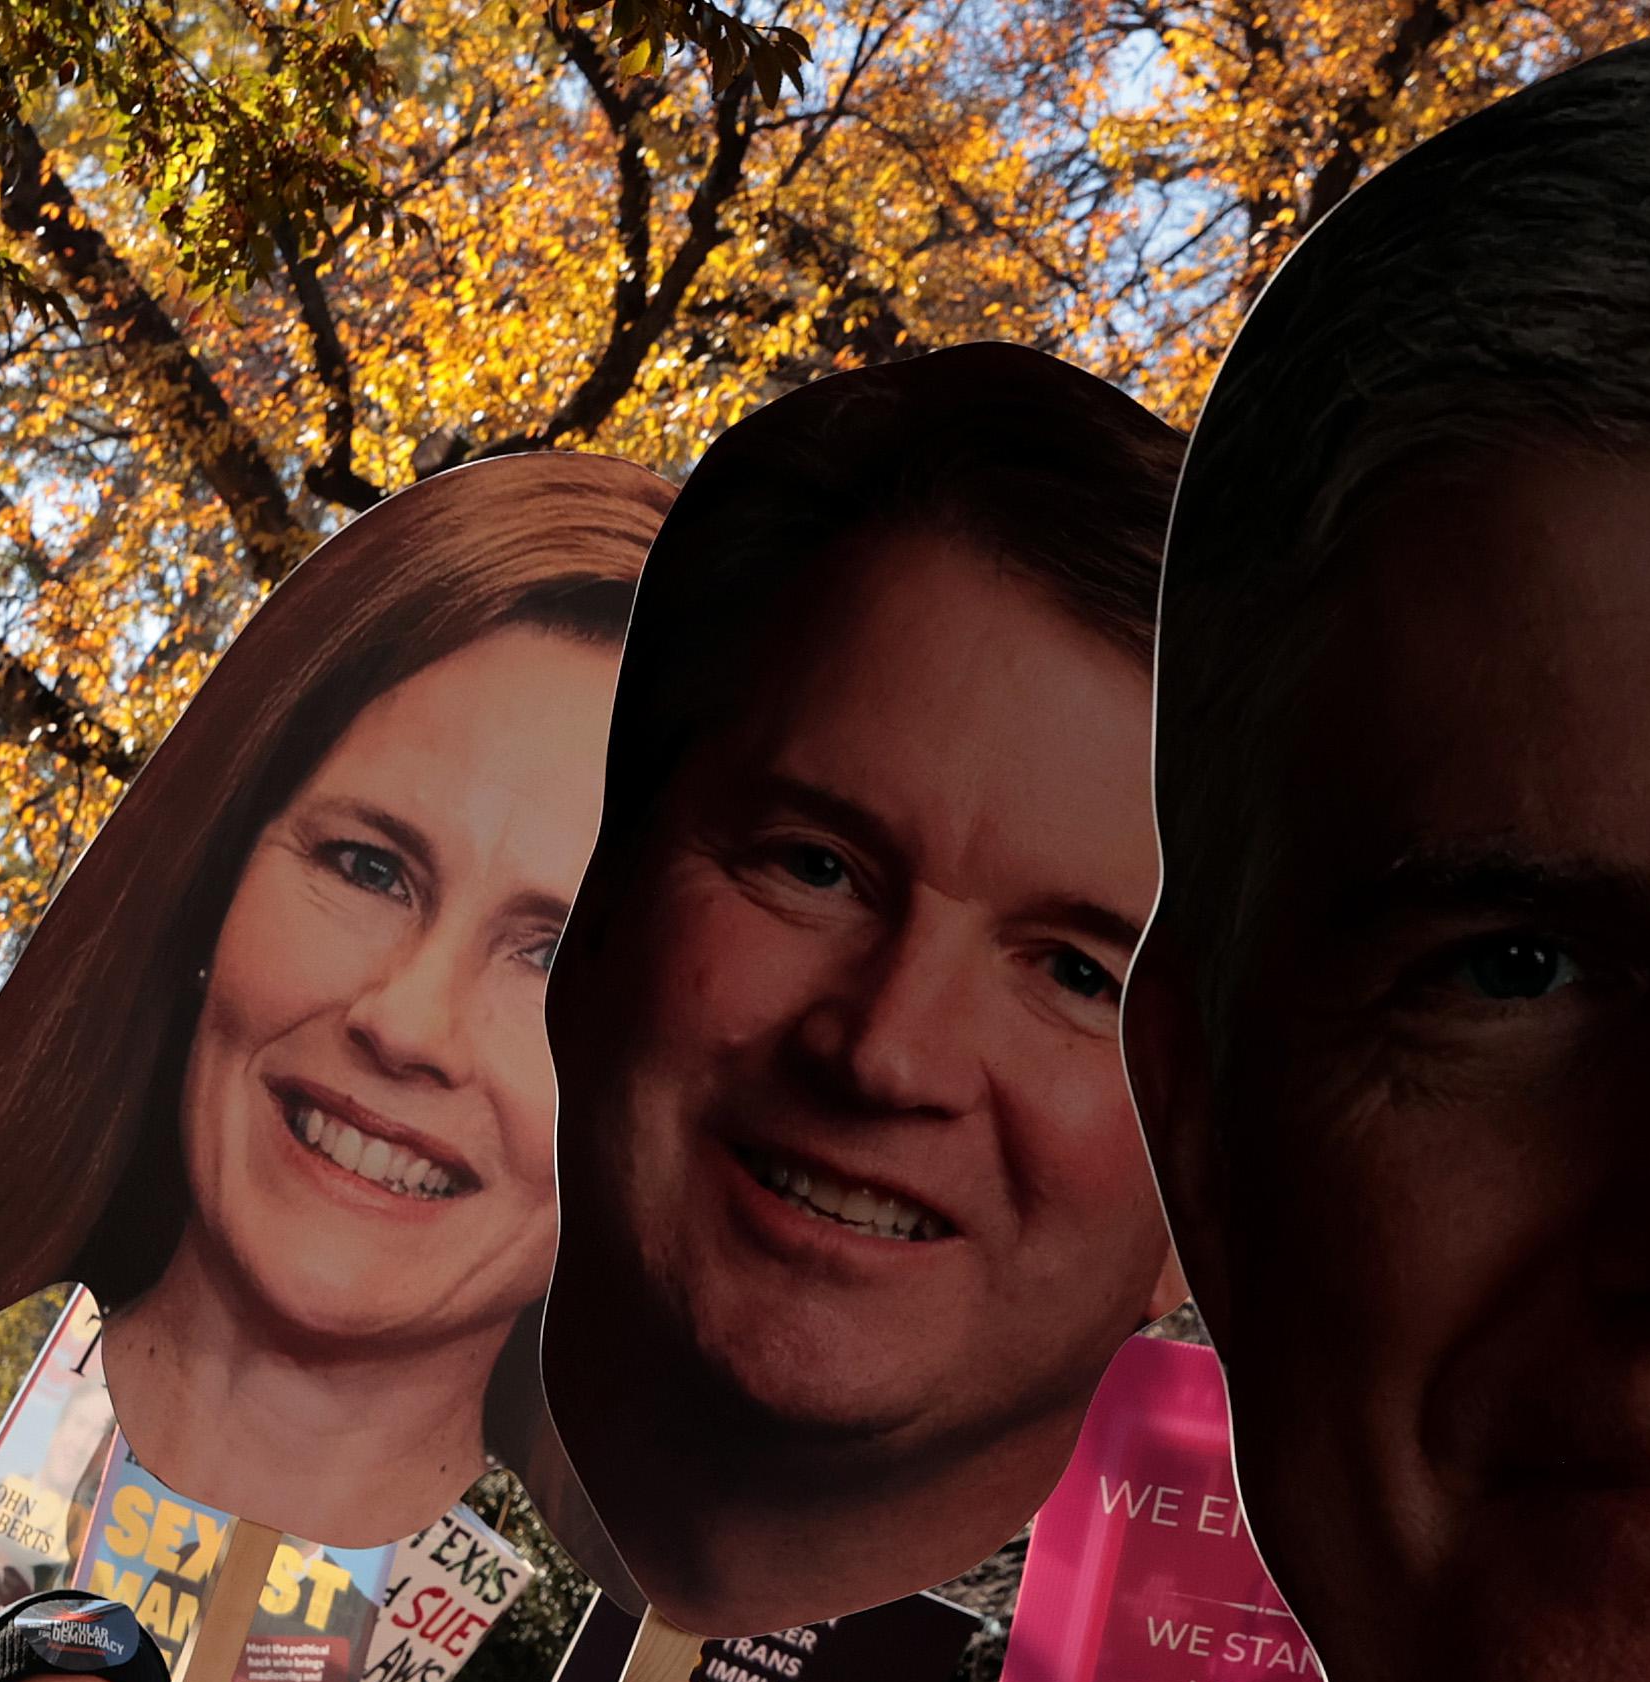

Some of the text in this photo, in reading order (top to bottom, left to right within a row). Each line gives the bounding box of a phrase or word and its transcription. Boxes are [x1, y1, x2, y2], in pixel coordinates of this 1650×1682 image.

[1099, 1474, 1185, 1529] WE
[54, 1620, 109, 1637] POPULAR
[391, 1587, 491, 1658] SUE
[52, 1628, 125, 1656] DEMOCRACY
[273, 1643, 288, 1655] the
[289, 1643, 330, 1656] political
[1147, 1615, 1324, 1678] WE STAN
[294, 1656, 325, 1671] brings
[303, 1671, 323, 1682] and
